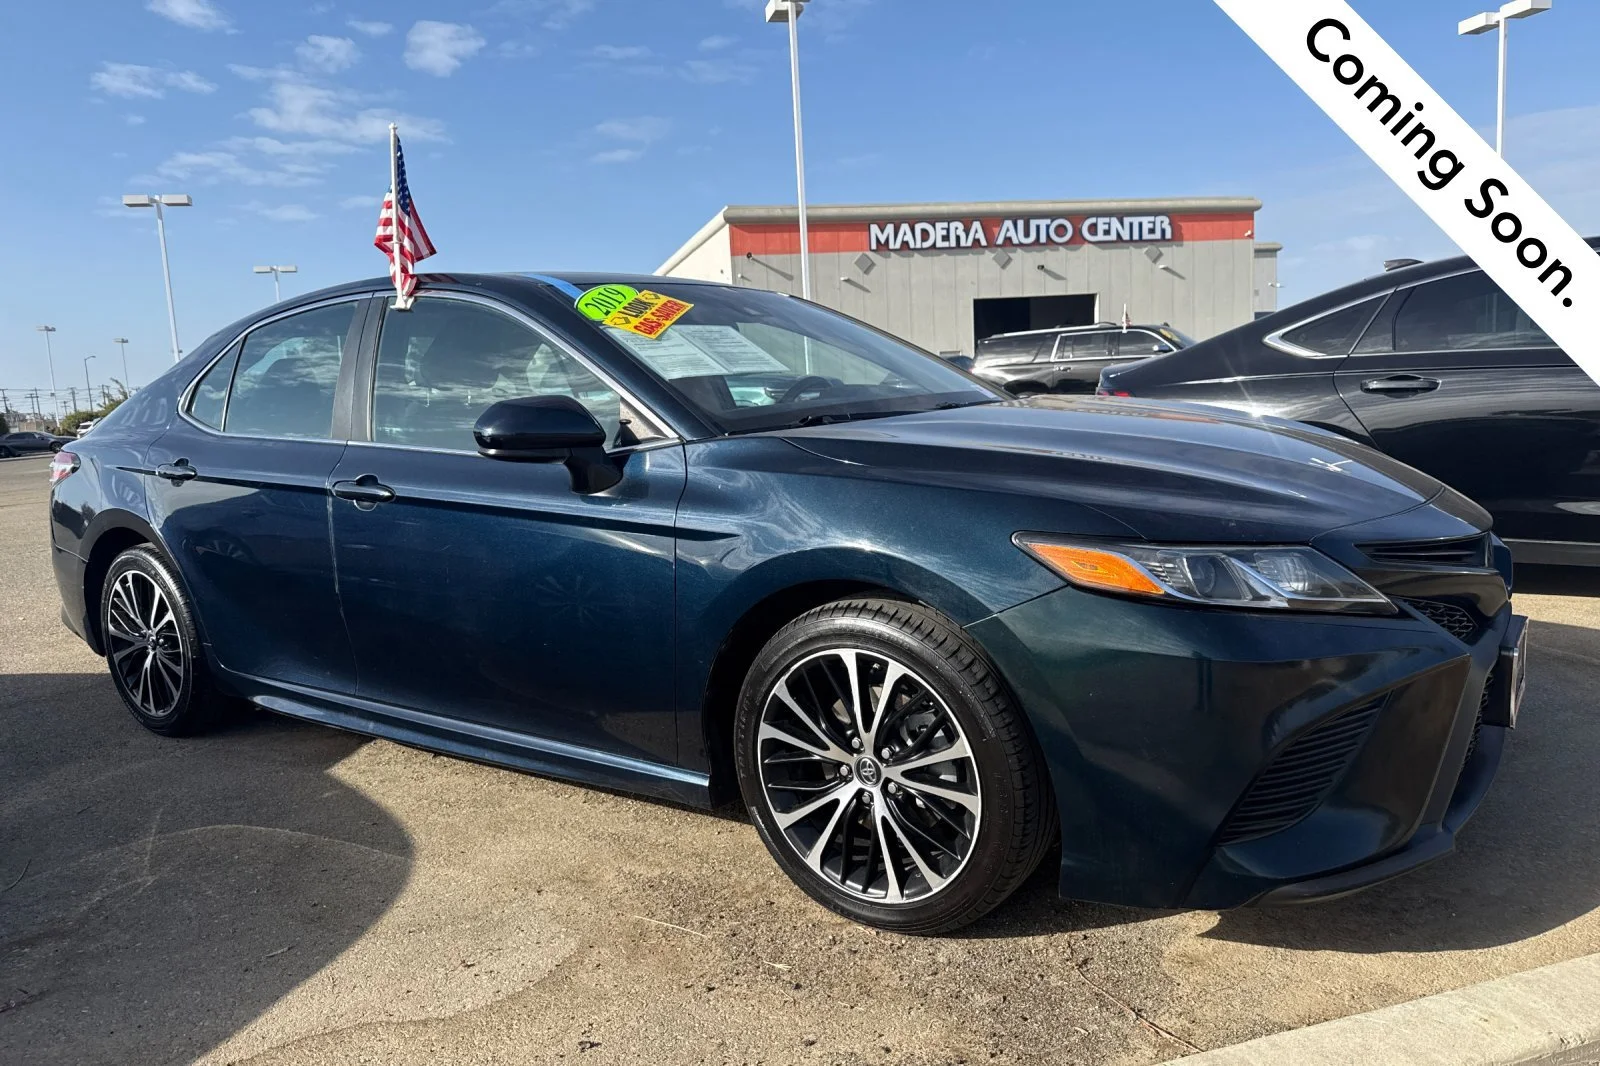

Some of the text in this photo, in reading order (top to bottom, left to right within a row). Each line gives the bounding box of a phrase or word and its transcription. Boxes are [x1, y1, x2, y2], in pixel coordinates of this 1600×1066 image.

[868, 214, 1173, 250] MADERA AUTO CENTER
[585, 287, 627, 316] 2019
[617, 297, 657, 319] LOOK
